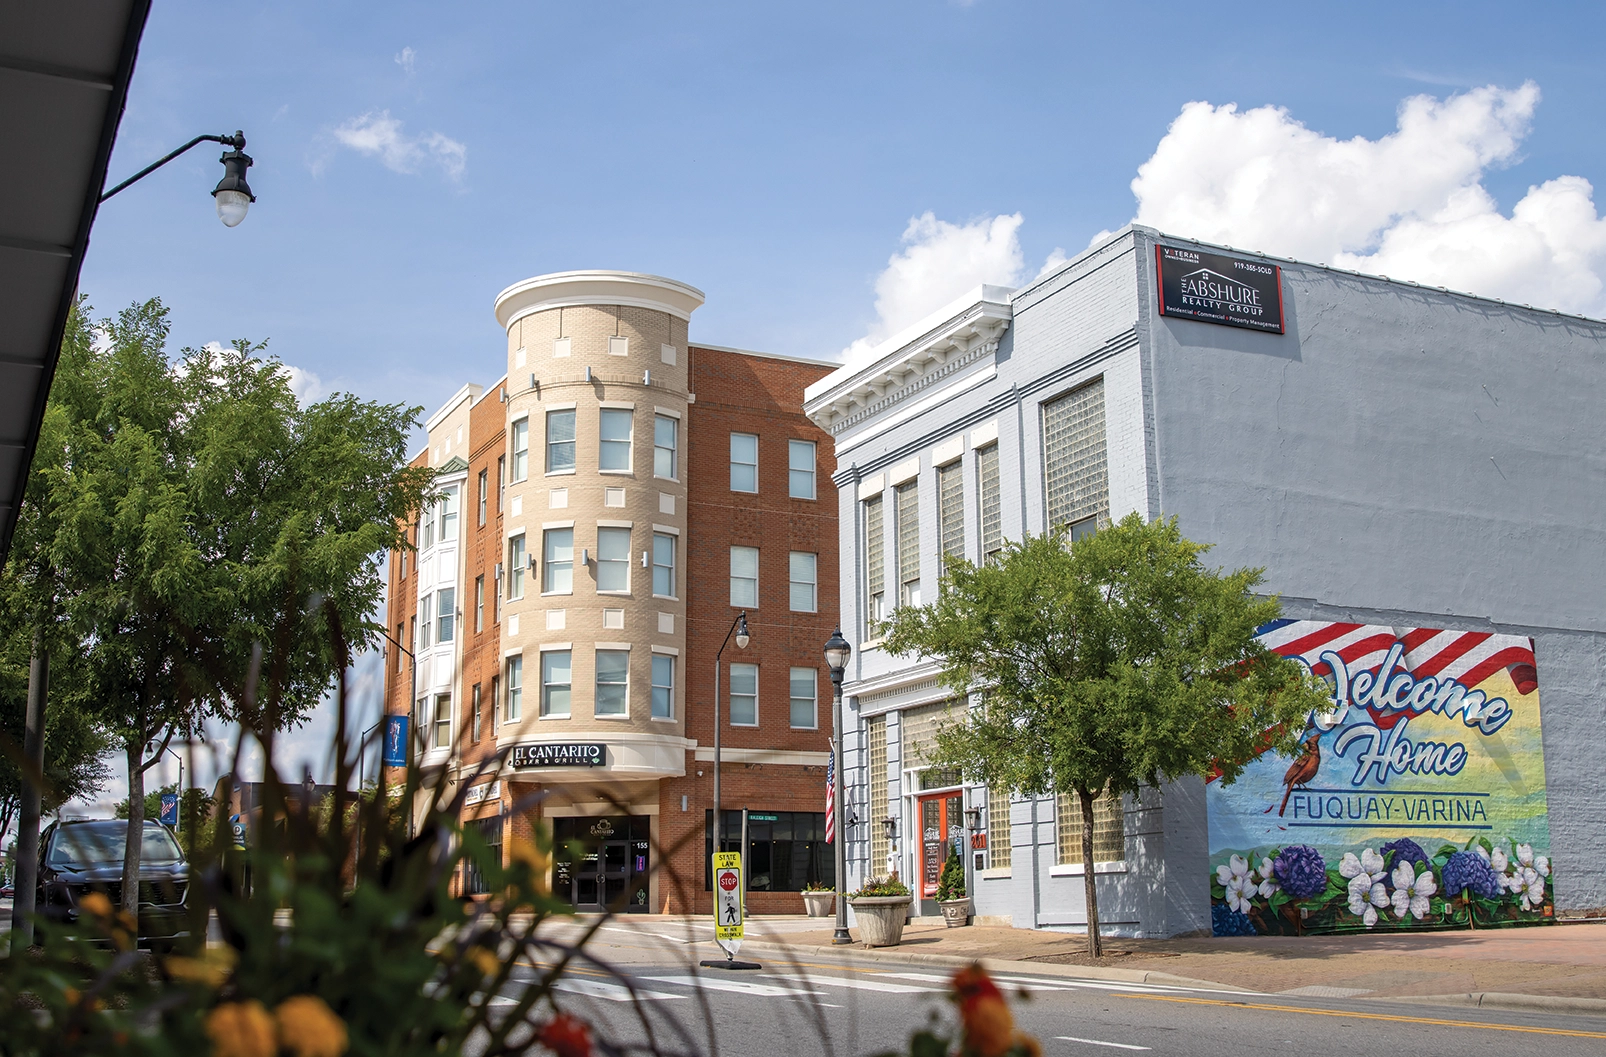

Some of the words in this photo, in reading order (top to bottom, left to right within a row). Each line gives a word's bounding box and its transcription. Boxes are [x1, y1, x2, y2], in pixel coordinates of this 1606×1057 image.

[1187, 279, 1262, 306] ABSHURE
[1166, 305, 1193, 315] Residential
[1197, 310, 1225, 320] Commercial
[1229, 316, 1249, 325] Property
[1250, 319, 1280, 329] Management
[1182, 296, 1221, 309] REALTY
[1228, 304, 1264, 316] GROUP
[515, 747, 526, 760] EL
[528, 745, 600, 759] CANTARITO
[1333, 716, 1469, 786] Home
[1293, 796, 1488, 822] FUQUAY-VARINA
[720, 877, 737, 886] STOP
